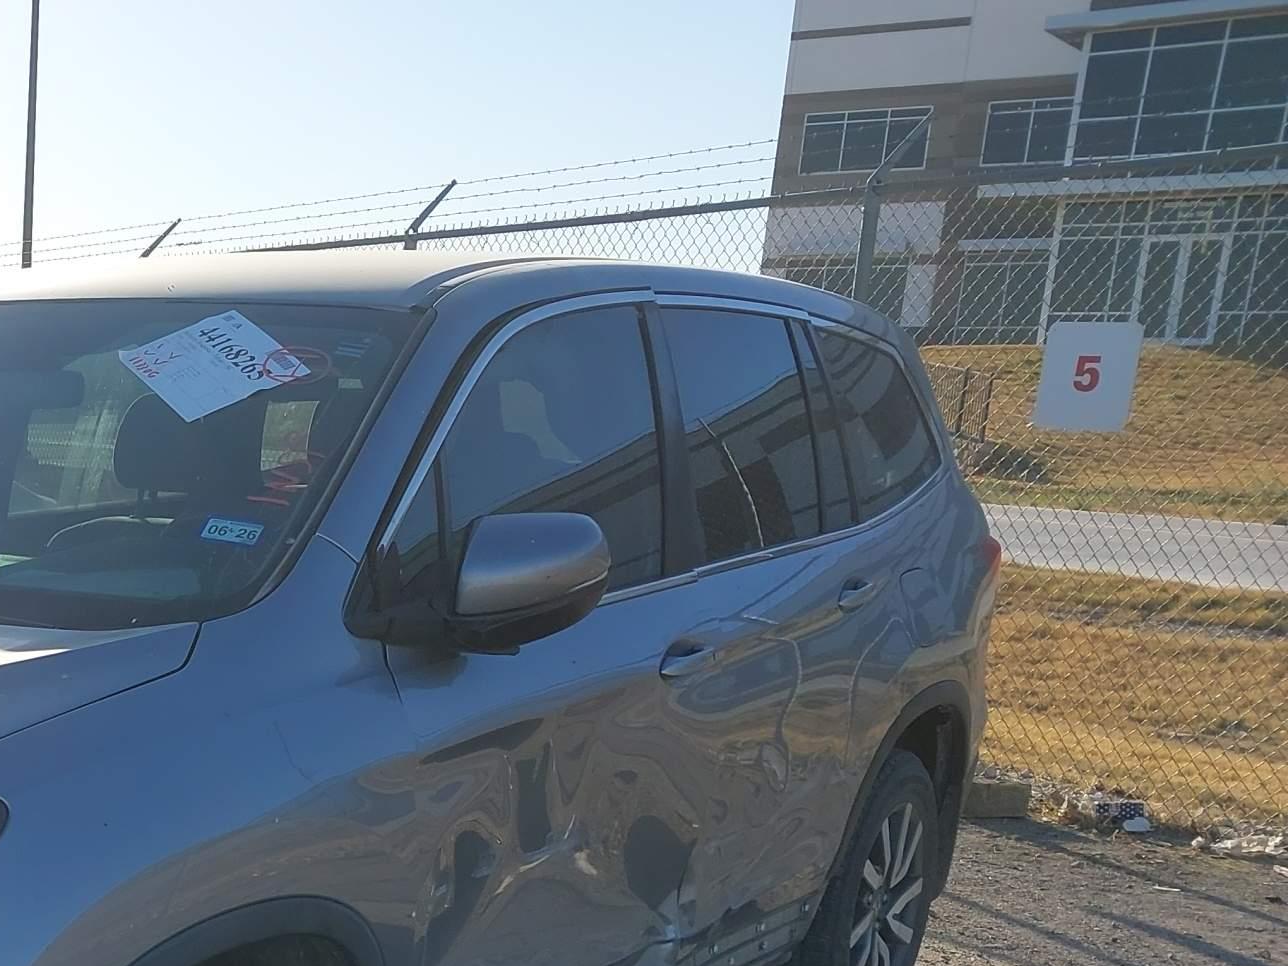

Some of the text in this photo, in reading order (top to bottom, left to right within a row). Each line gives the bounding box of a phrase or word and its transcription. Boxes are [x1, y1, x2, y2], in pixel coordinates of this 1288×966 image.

[198, 326, 272, 381] 44168265
[1072, 355, 1102, 393] 5
[207, 524, 258, 541] 06 26
